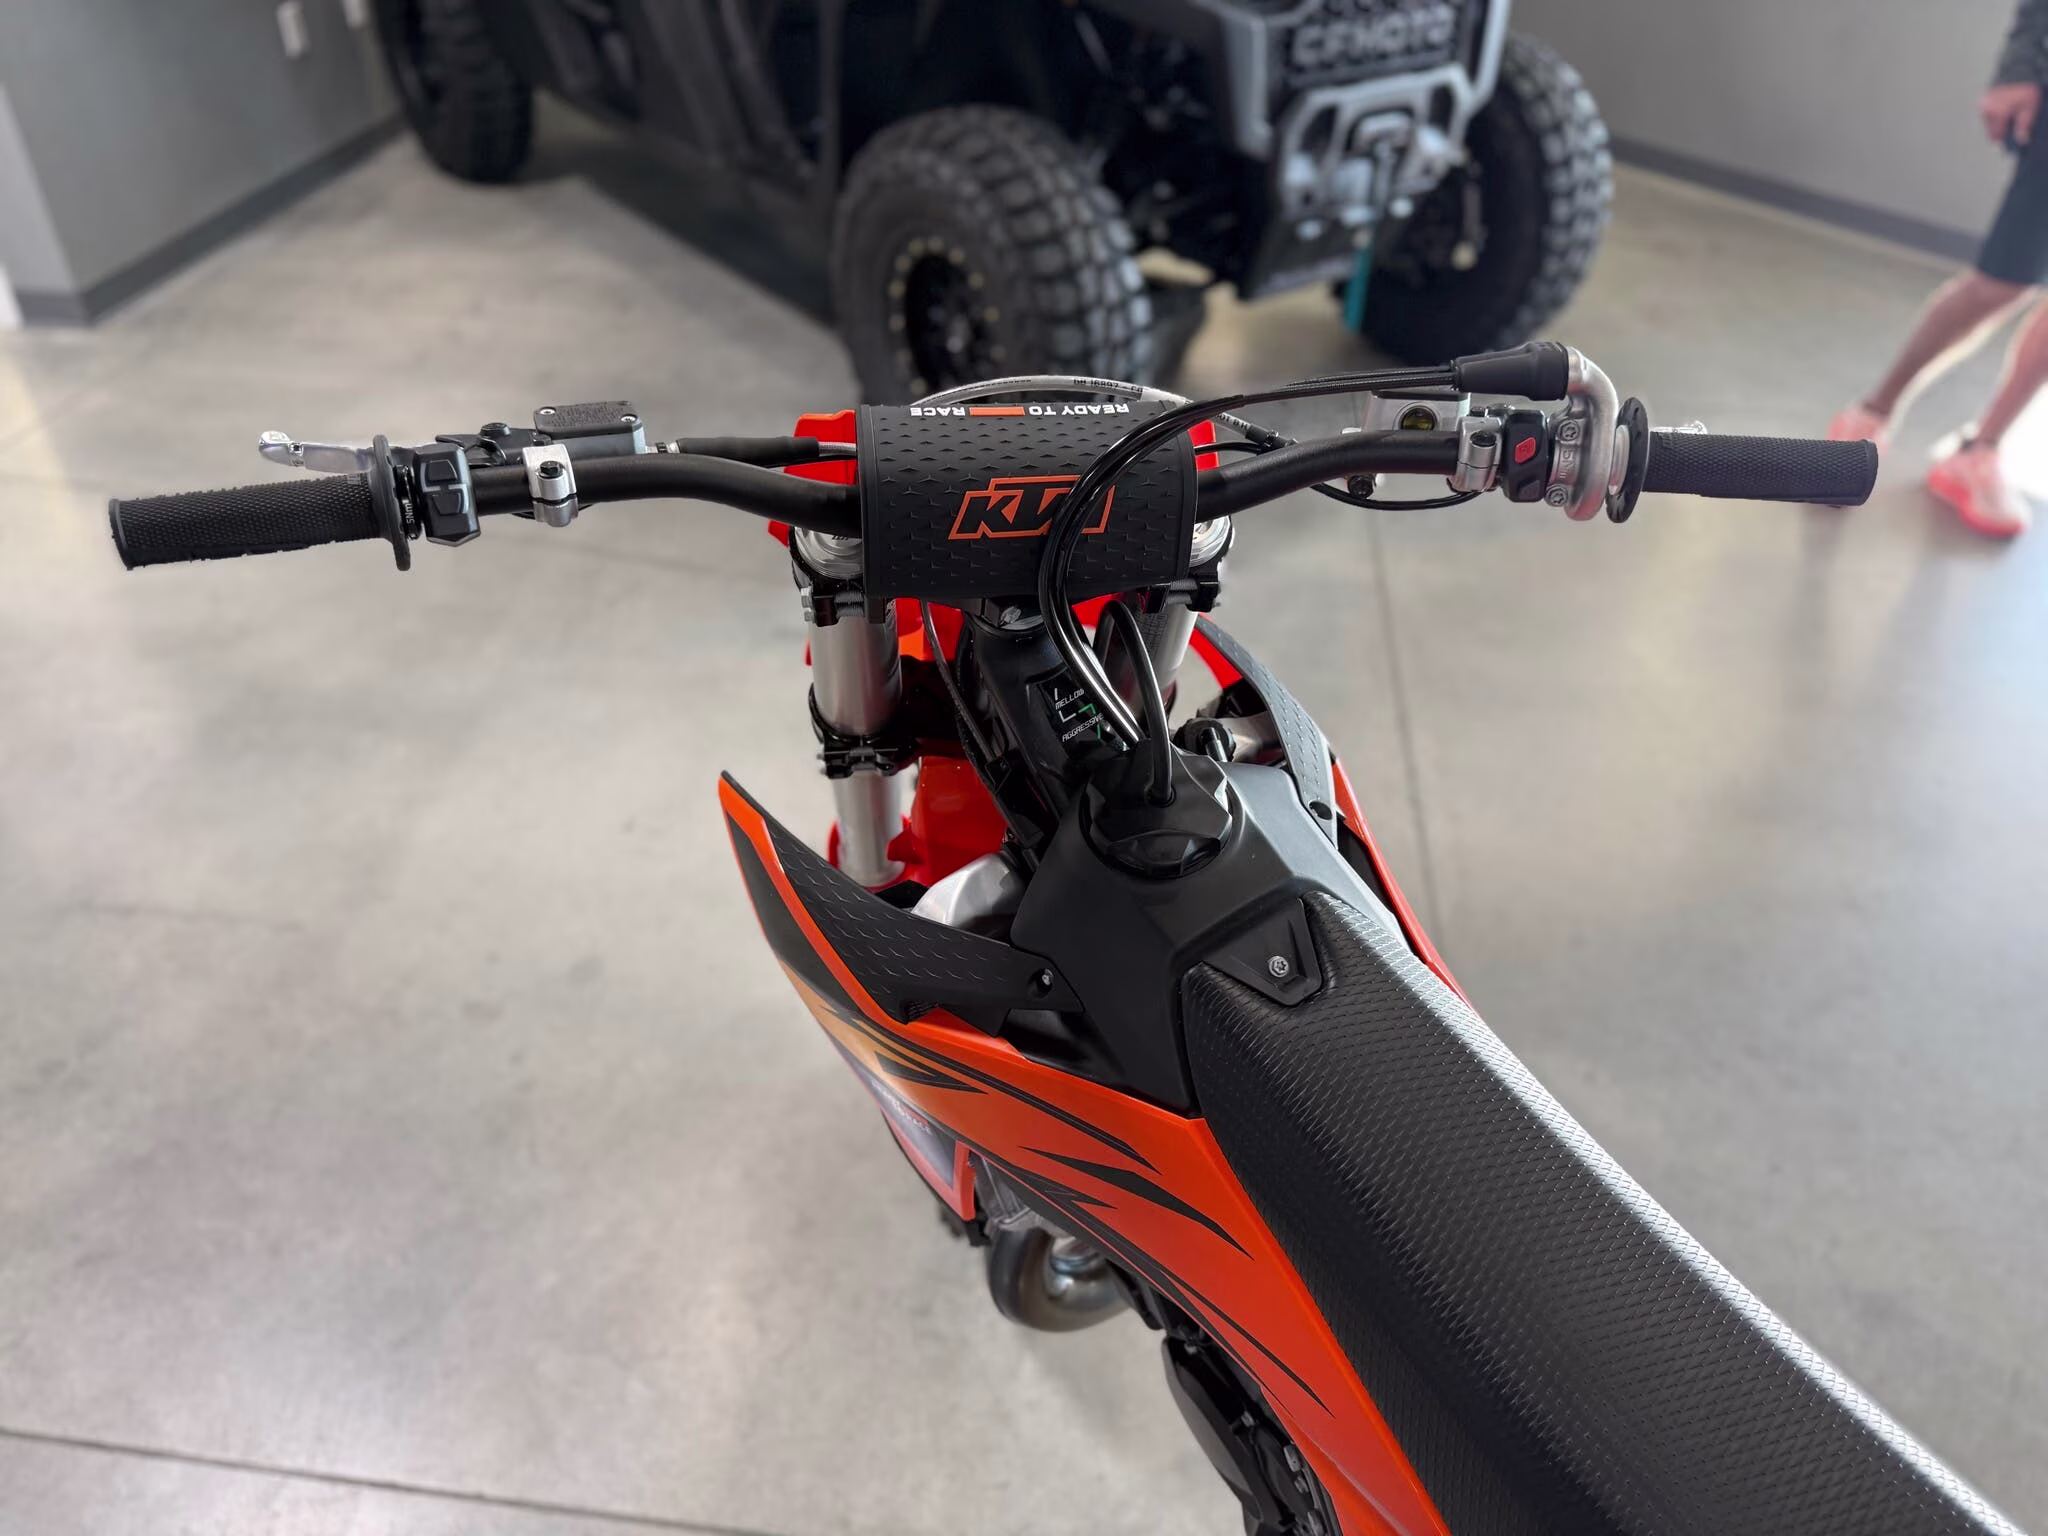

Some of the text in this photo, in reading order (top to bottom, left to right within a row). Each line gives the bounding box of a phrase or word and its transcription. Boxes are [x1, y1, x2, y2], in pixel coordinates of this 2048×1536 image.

[910, 403, 1130, 417] READY TO RACE
[1055, 688, 1085, 710] MELLOW
[1062, 712, 1104, 742] AGGRESSIVE
